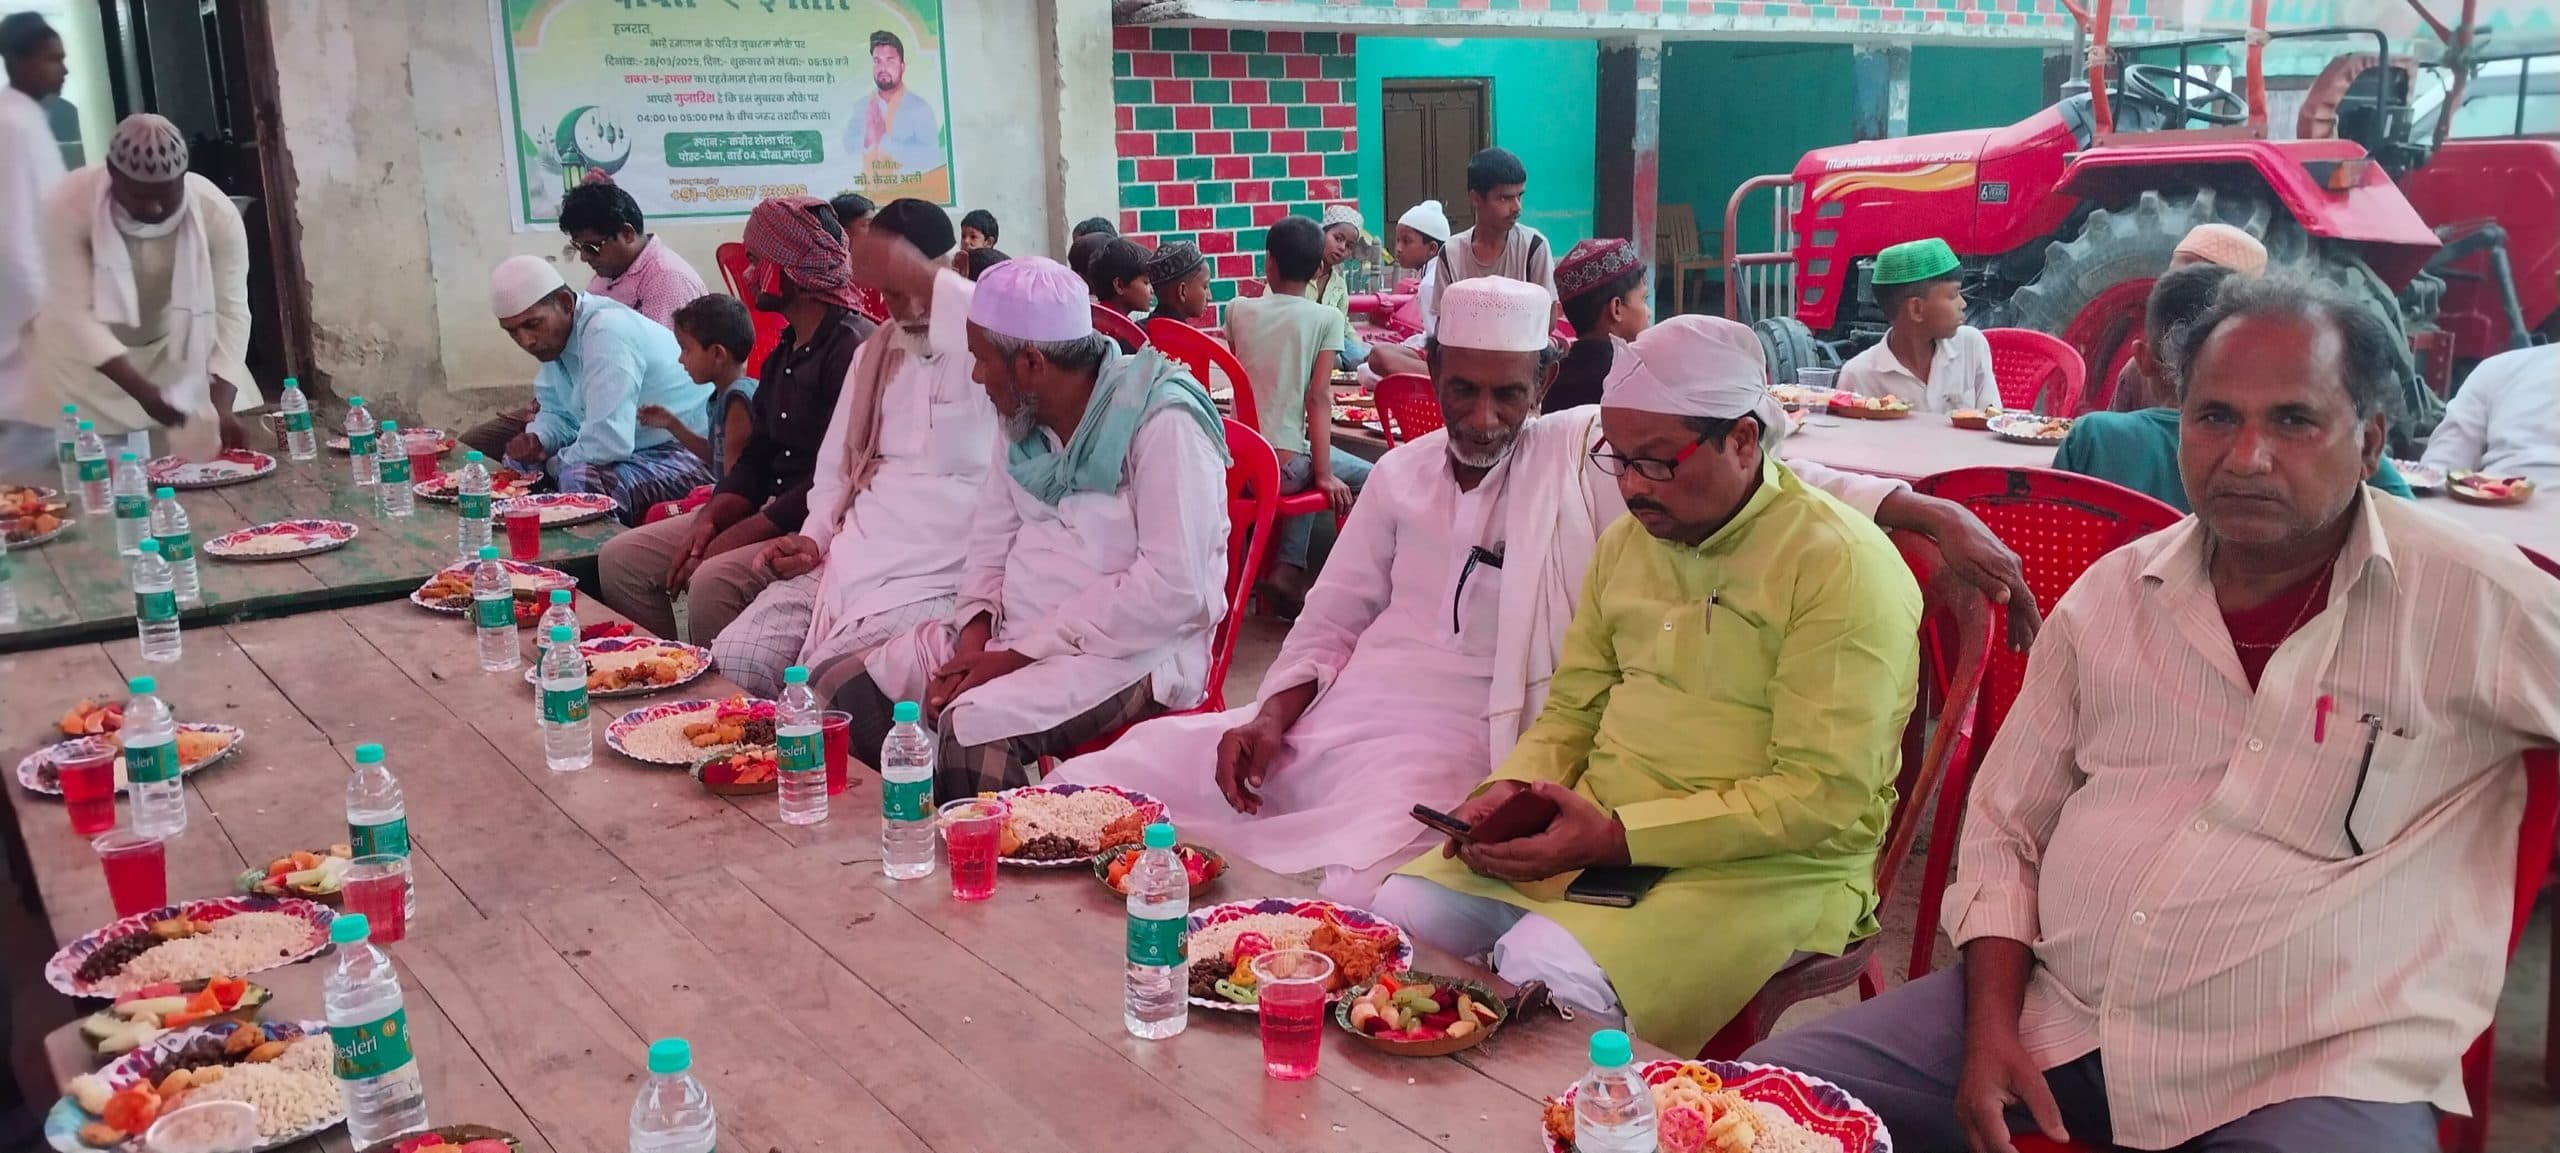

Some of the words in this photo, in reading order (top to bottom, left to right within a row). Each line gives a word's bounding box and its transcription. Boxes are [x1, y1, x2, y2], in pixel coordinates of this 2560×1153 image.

[704, 37, 714, 48] के
[694, 74, 707, 83] का
[668, 114, 678, 122] to
[709, 113, 724, 121] PM
[1981, 185, 1988, 200] 6
